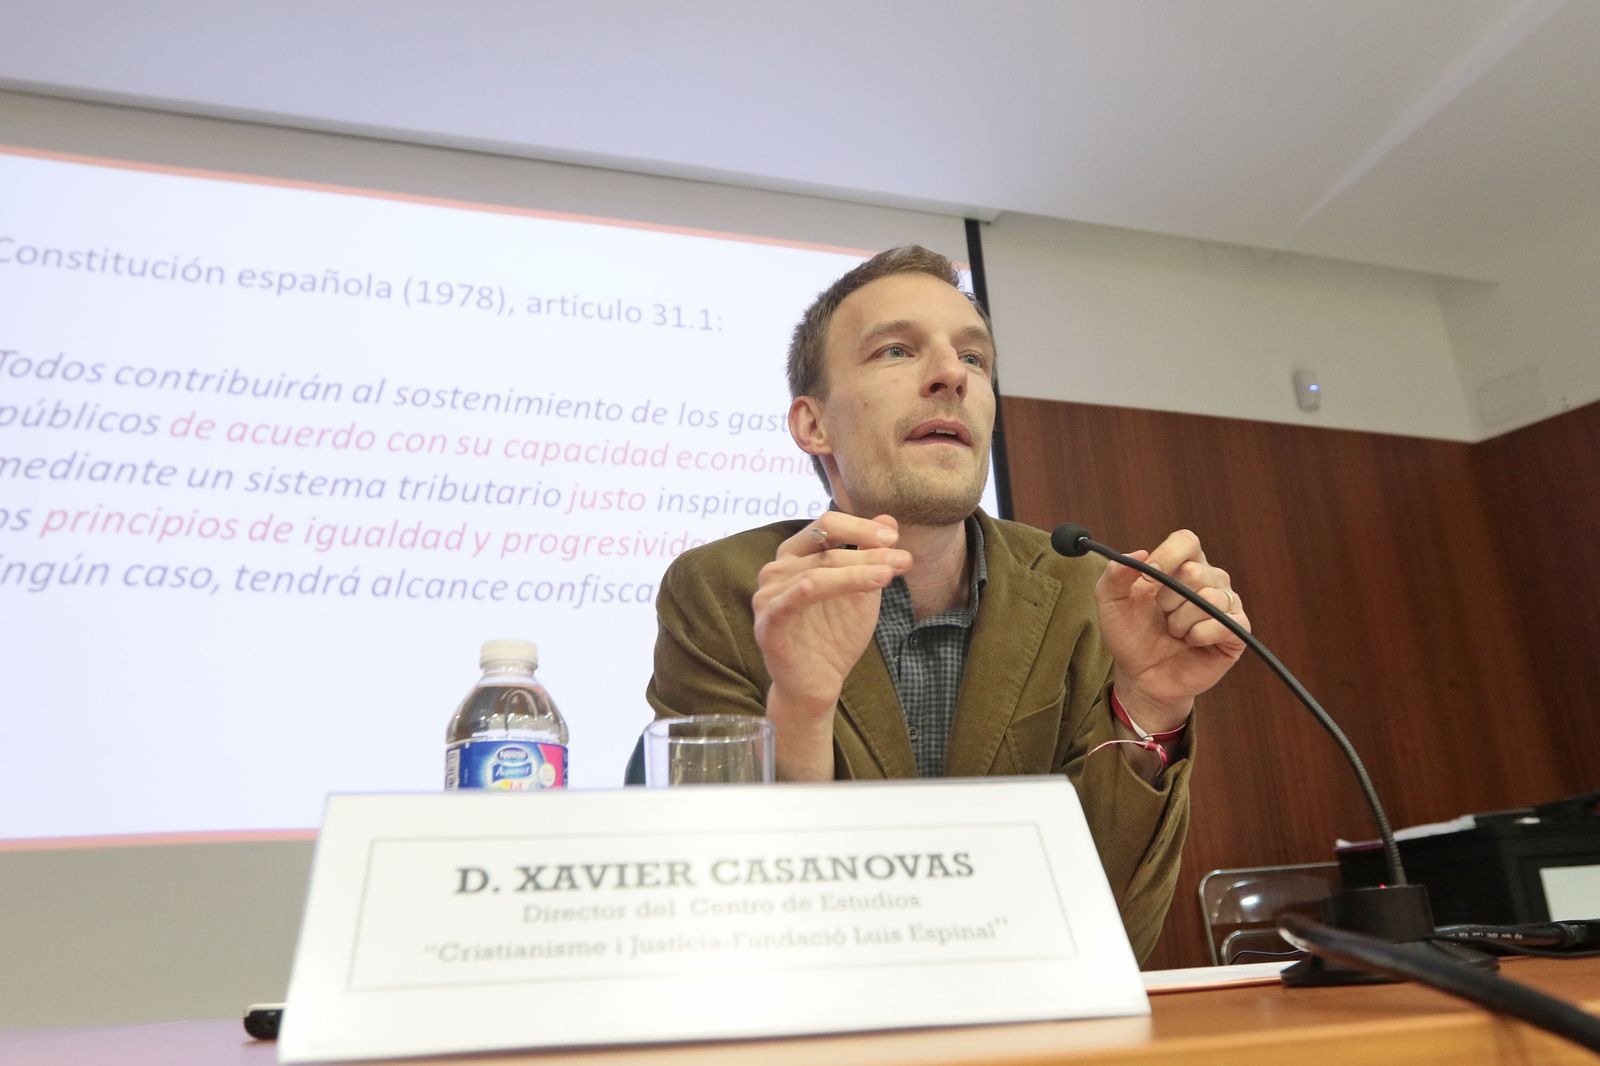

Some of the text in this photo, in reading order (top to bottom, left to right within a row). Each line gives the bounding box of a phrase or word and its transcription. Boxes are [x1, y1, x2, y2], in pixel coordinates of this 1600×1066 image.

[0, 236, 724, 333] Constitución española (1978), artículo 31.1:
[0, 348, 787, 436] Todos contribuirán al sostenimiento de los gast
[169, 409, 217, 442] de
[226, 420, 377, 452] acuerdo
[386, 428, 448, 456] con
[455, 431, 493, 458] su
[503, 433, 671, 470] capacidad
[676, 446, 816, 478] económic
[187, 464, 235, 492] un
[243, 465, 386, 502] sistema
[398, 472, 563, 510] tributario
[564, 484, 648, 516] justo
[657, 484, 801, 521] inspirado
[806, 499, 823, 520] e
[39, 501, 241, 546] principios
[247, 511, 295, 545] de
[303, 514, 468, 555] igualdad
[470, 527, 493, 560] y
[498, 522, 706, 564] progresivid
[0, 550, 655, 613] ngún caso, tendrá alcance confisca
[454, 851, 976, 895] D. XAVIER CASANOVAS
[523, 901, 627, 924] Director
[635, 897, 676, 919] del
[782, 893, 813, 913] de
[820, 892, 921, 912] Estudios
